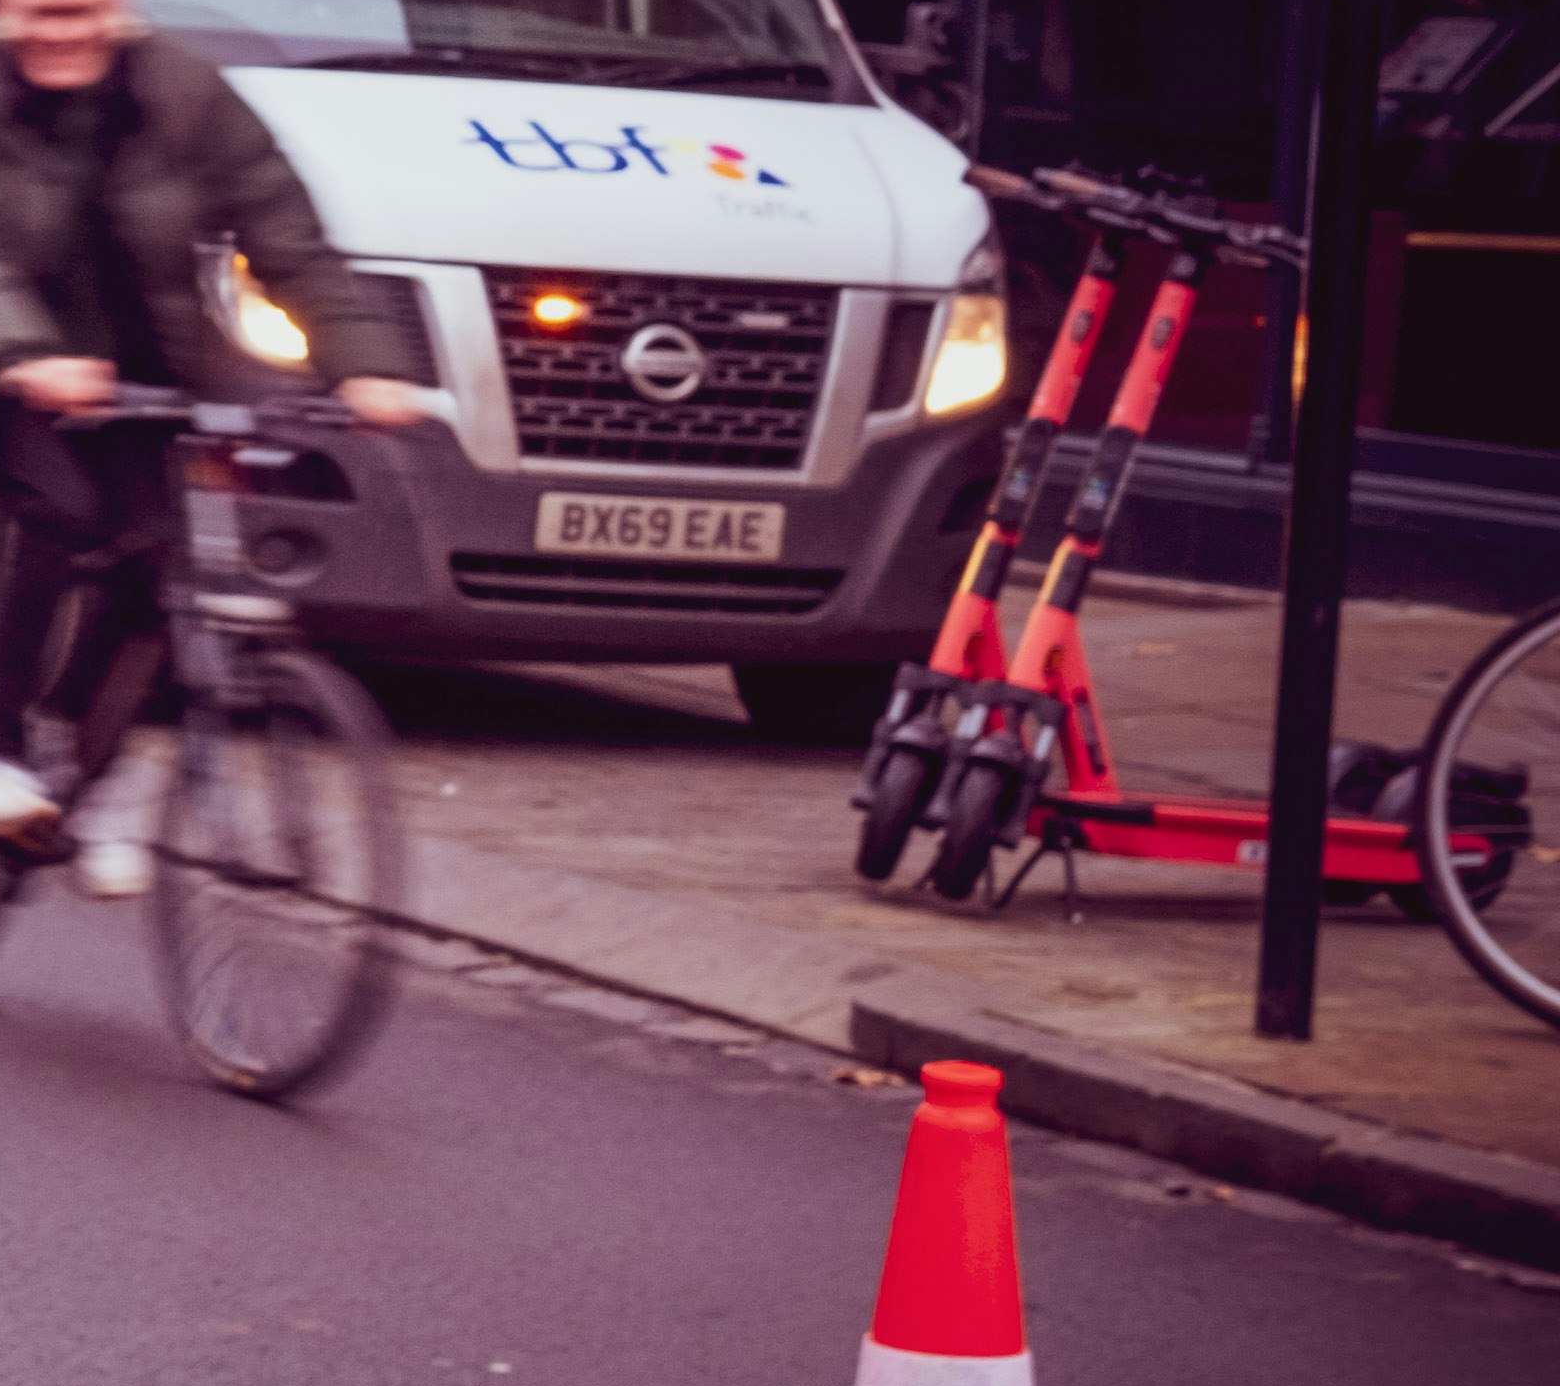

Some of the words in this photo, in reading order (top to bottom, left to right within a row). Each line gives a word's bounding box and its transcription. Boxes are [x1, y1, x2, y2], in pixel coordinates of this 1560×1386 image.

[462, 117, 671, 176] tbf
[561, 504, 671, 549] BX69
[685, 509, 762, 553] EAE
